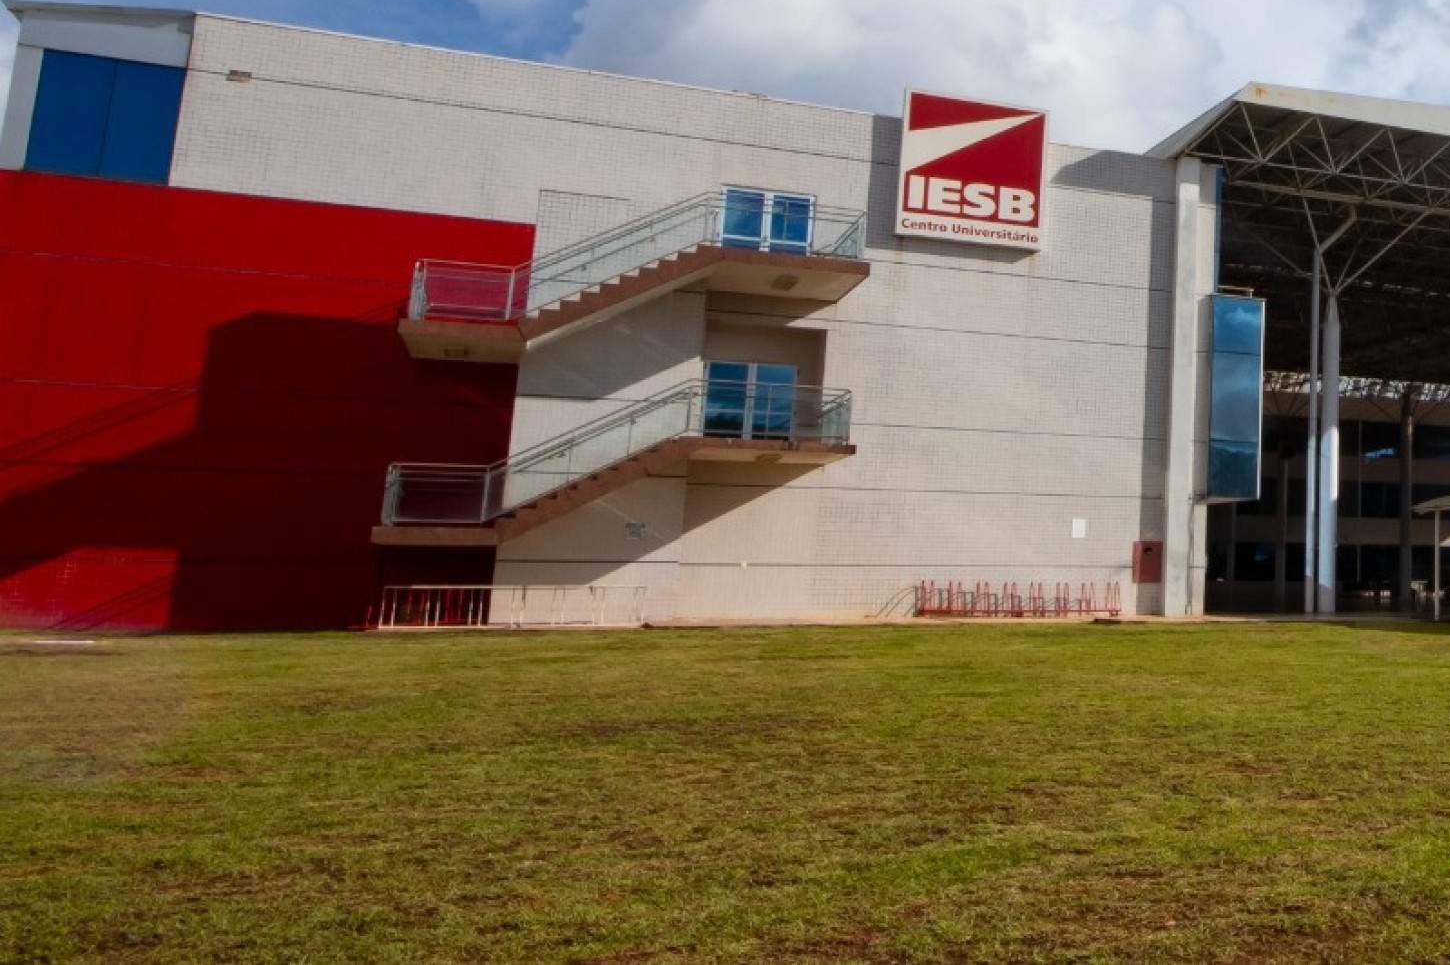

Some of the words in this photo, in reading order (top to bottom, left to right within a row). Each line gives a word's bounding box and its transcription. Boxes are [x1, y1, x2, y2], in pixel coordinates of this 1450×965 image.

[907, 174, 1036, 222] IESB
[901, 218, 948, 233] Centro
[952, 223, 1039, 243] Universitário
